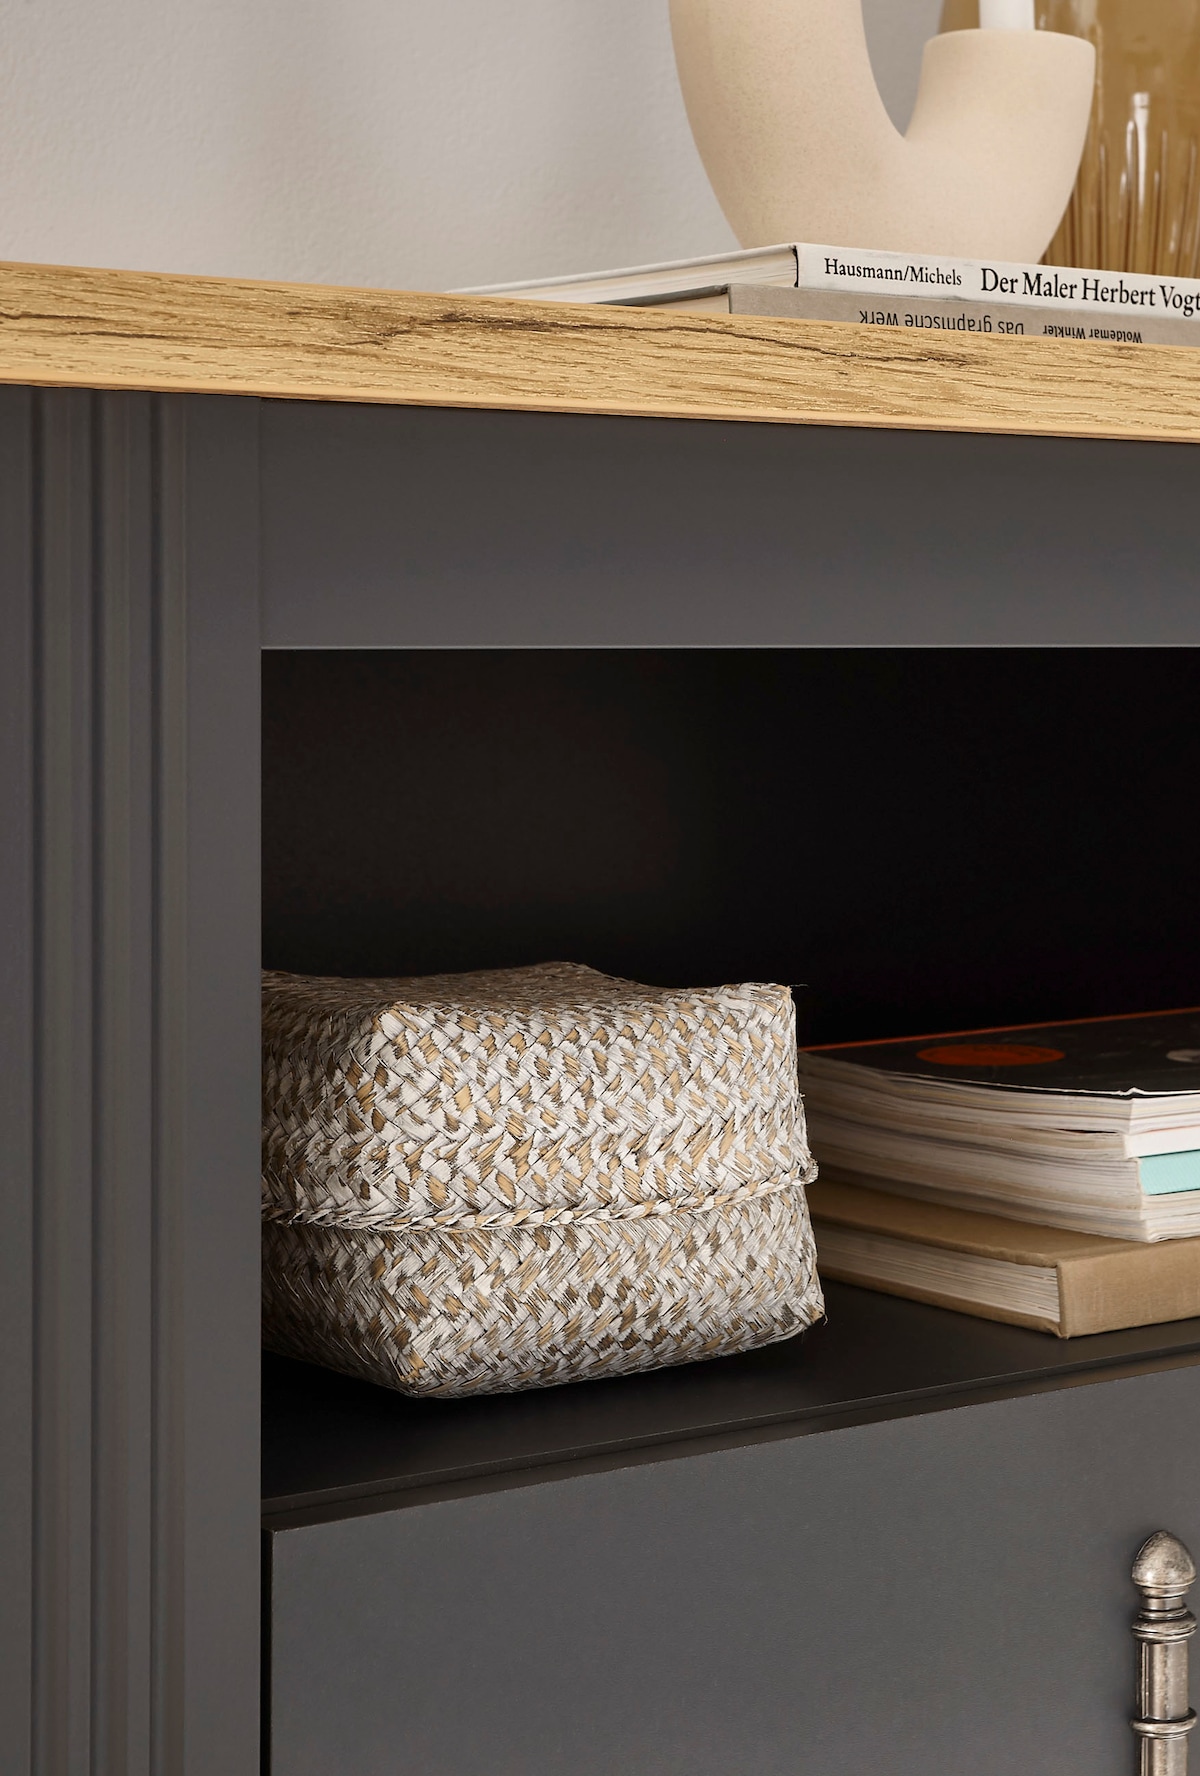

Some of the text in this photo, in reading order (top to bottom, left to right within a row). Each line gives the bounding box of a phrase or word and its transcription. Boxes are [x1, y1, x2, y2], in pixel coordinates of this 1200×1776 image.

[823, 257, 963, 286] Hausmann/Michels
[980, 267, 1019, 294] Der
[1022, 271, 1078, 299] Maler
[1081, 277, 1156, 306] Herbert
[1042, 323, 1085, 340] Winkler
[1088, 327, 1143, 344] Woldemar
